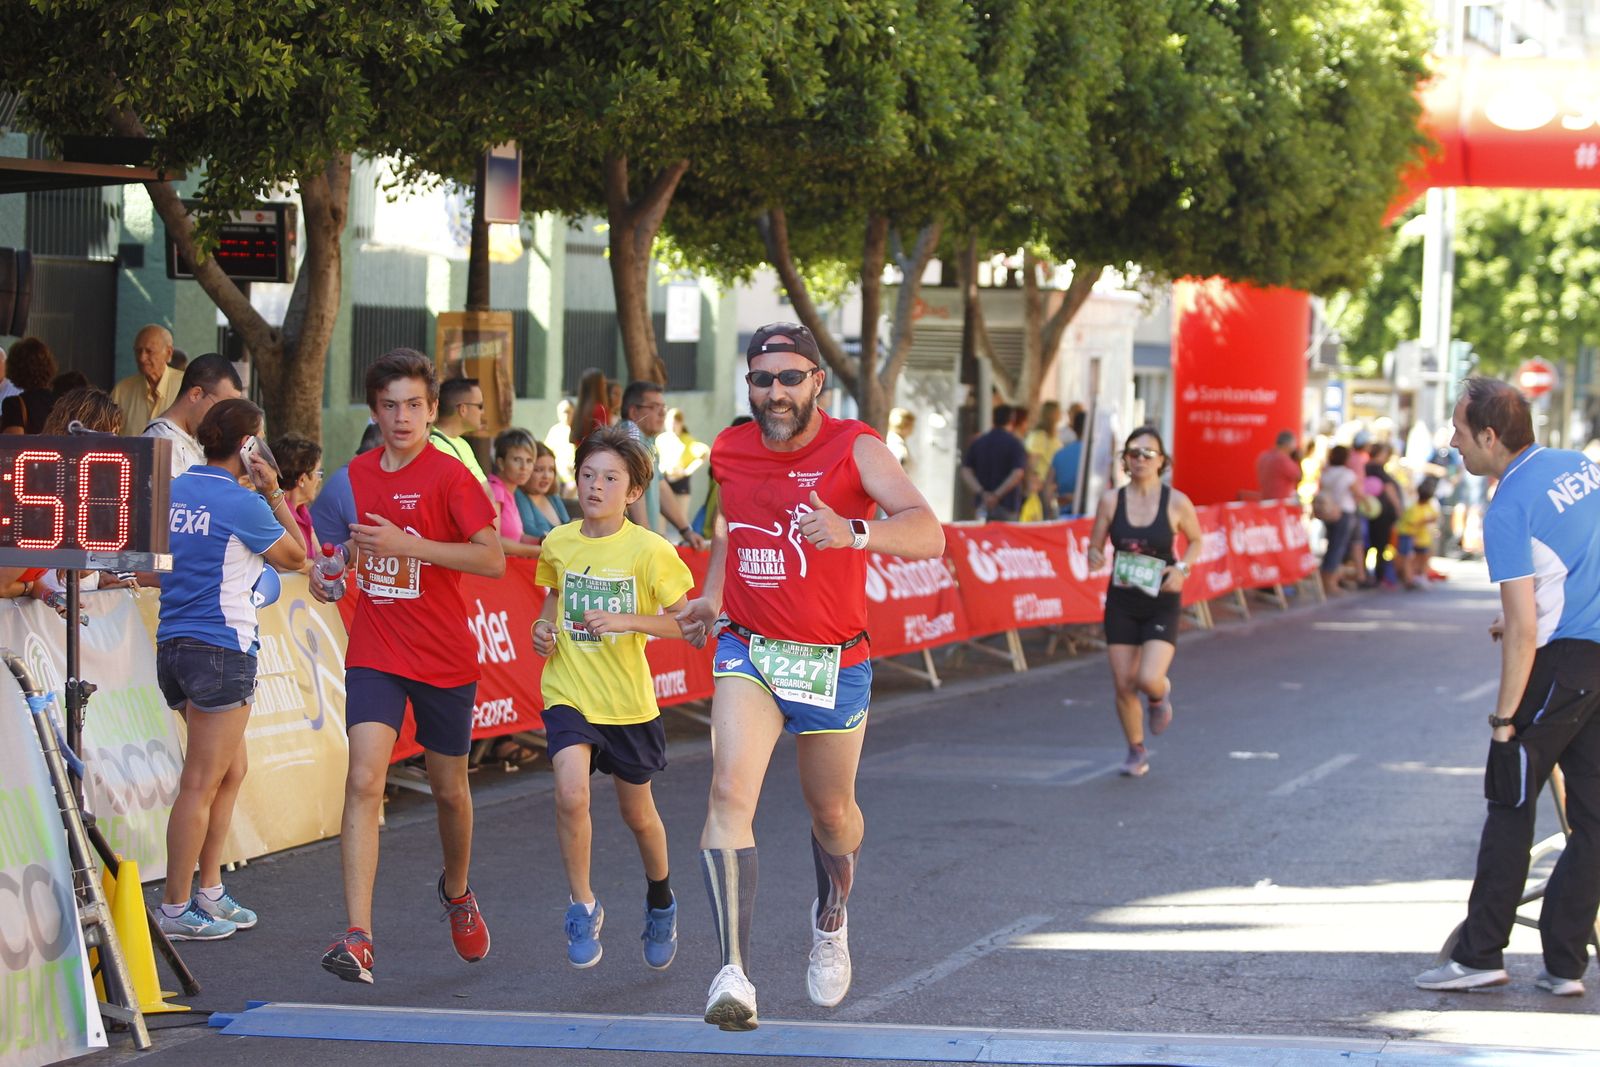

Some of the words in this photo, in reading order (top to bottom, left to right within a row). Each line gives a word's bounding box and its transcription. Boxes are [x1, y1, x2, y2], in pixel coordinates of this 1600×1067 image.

[738, 548, 785, 563] CARRERA
[365, 555, 400, 576] 330
[738, 561, 786, 575] SOLIDARIA
[369, 572, 396, 585] FERNANDO
[569, 591, 622, 614] 1118
[759, 655, 824, 681] 1247
[771, 677, 813, 690] VERGARUCHI
